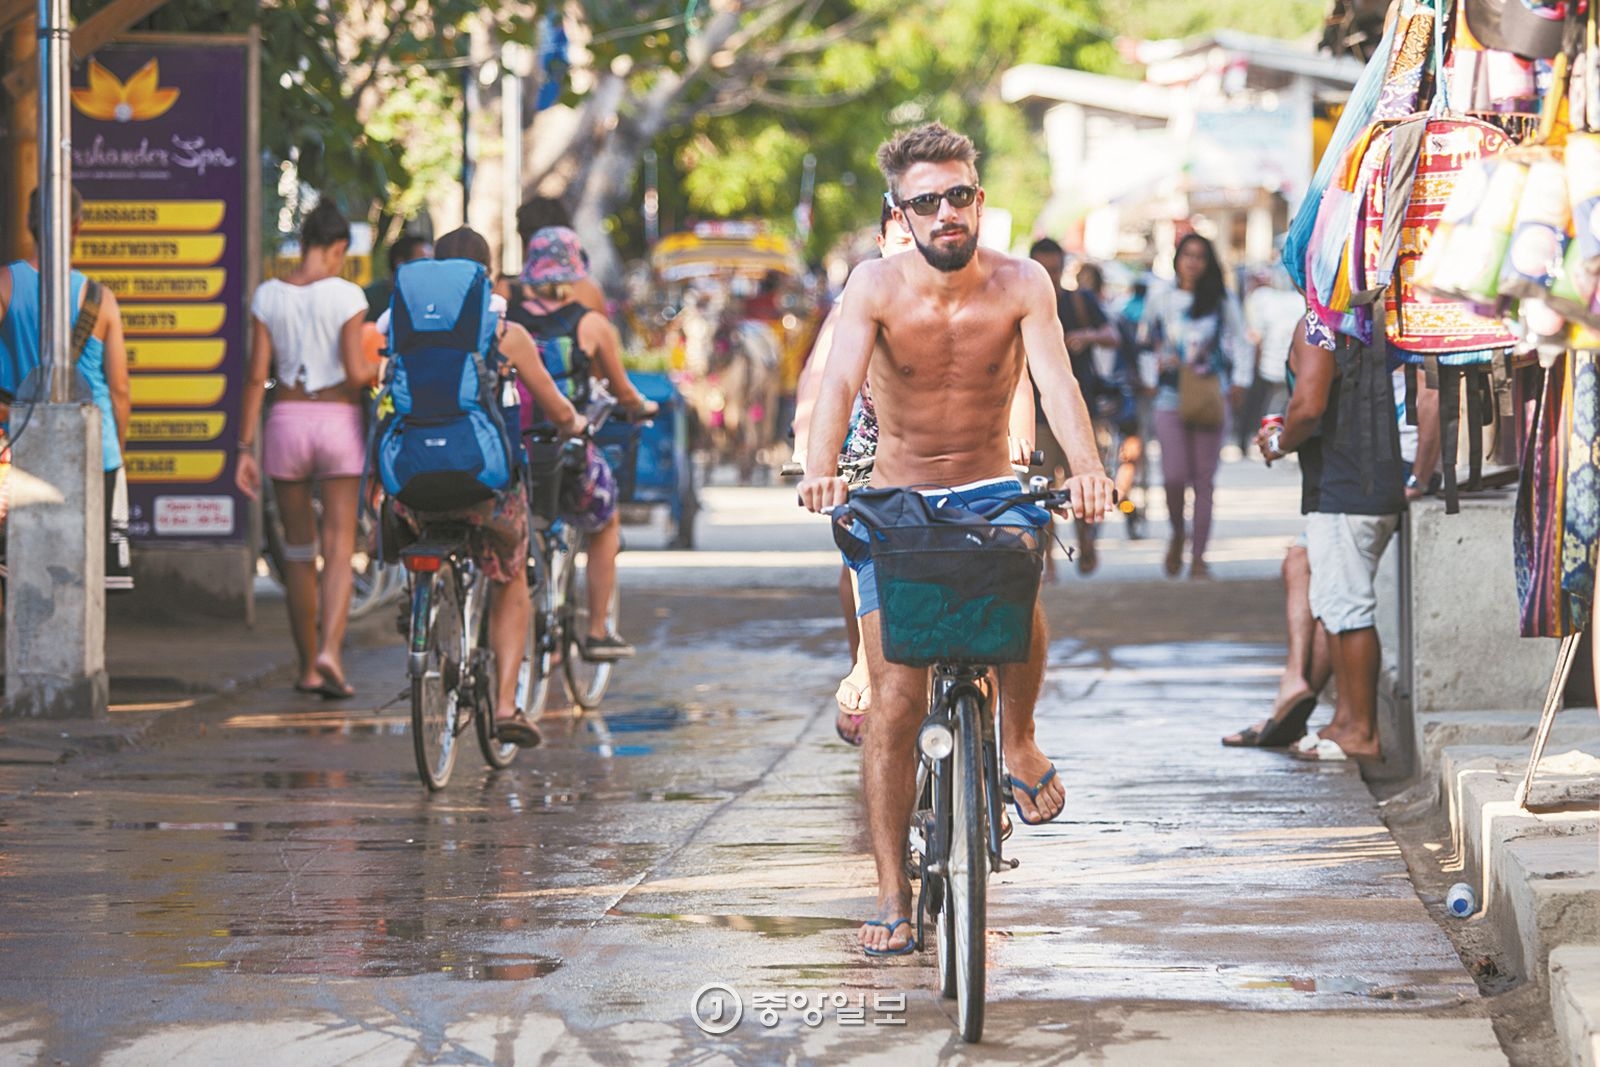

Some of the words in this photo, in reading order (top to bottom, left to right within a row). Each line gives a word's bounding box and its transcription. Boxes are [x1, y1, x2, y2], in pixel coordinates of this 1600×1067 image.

[171, 134, 236, 175] Spa
[82, 242, 178, 256] TREATMENTS
[134, 278, 208, 291] TREATMENTS
[121, 312, 176, 326] TMENTS
[130, 421, 209, 434] TREATMENTS
[127, 458, 175, 471] CKAGE
